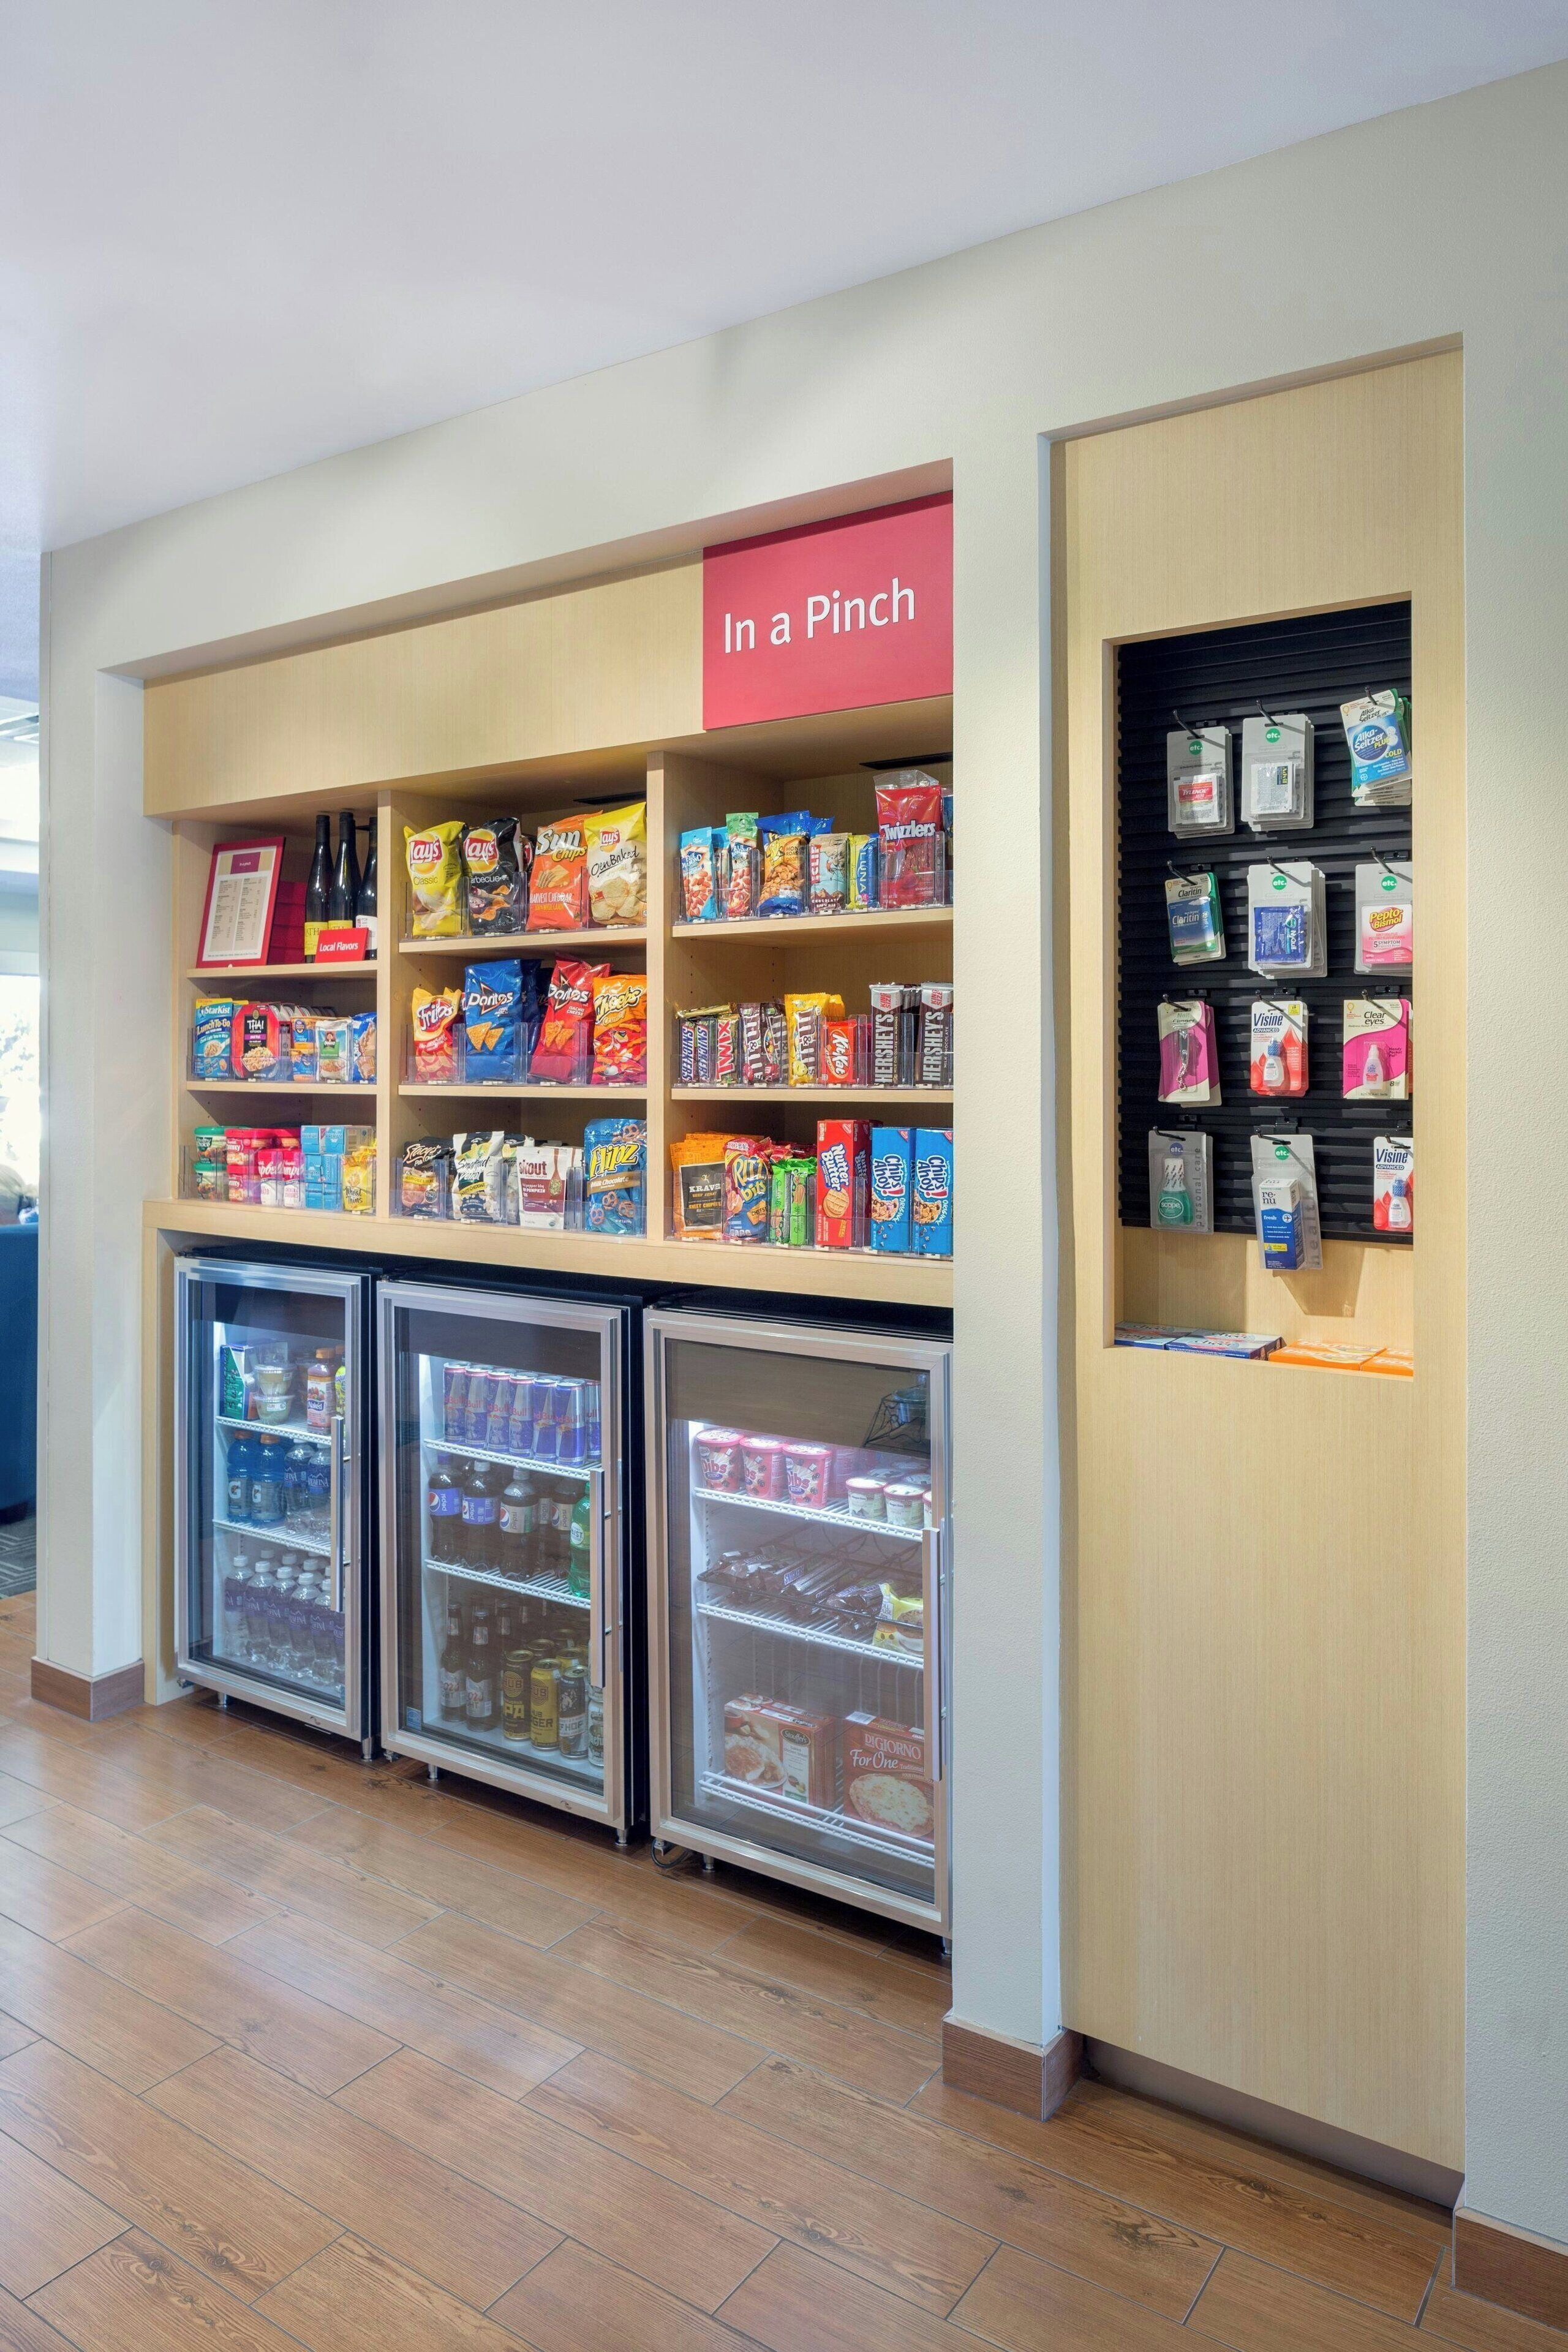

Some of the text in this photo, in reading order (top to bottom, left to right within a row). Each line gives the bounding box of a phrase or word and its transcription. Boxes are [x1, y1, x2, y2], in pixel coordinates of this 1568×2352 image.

[725, 576, 915, 654] In a Pinch
[1354, 732, 1384, 752] Seltzer
[1355, 729, 1378, 744] Alka-
[1374, 737, 1390, 749] PLUS
[1385, 748, 1402, 758] COLD
[600, 829, 620, 846] Lay's
[881, 820, 936, 841] Twizzlers
[466, 837, 495, 862] Lay's
[535, 829, 581, 855] Sun
[410, 839, 442, 864] Lay's
[552, 846, 587, 862] Chips
[610, 845, 639, 866] Baked
[413, 876, 438, 886] Classic
[470, 875, 500, 884] arbecue
[1178, 888, 1202, 898] Claritin
[1172, 914, 1199, 925] Claritin
[1369, 908, 1404, 923] Pepto-
[1374, 914, 1403, 930] Bismol
[319, 942, 336, 952] Local
[336, 941, 359, 951] Flavors
[468, 992, 513, 1006] Doritos
[548, 984, 589, 1002] Doritos
[205, 1005, 230, 1014] StarKist
[417, 1000, 454, 1031] Fritos
[197, 1020, 215, 1035] Lunch
[247, 1019, 264, 1030] THAI
[1254, 1012, 1283, 1027] Visine
[1365, 1018, 1384, 1027] eyes
[698, 1027, 709, 1080] SNICKERS
[716, 1020, 733, 1080] TWIX
[875, 1014, 894, 1084] HERSHEY'S
[923, 1011, 944, 1081] HERSHEY'S
[682, 1028, 694, 1082] SNICKERS
[404, 1144, 442, 1164] Stacy's
[590, 1144, 639, 1179] Flipz
[1376, 1148, 1408, 1164] Visine
[733, 1158, 767, 1187] RITZ
[821, 1150, 842, 1191] Butter
[831, 1144, 850, 1186] Nutter
[884, 1155, 902, 1189] Chips
[927, 1156, 946, 1190] Chips
[601, 1176, 629, 1186] Chocolate
[689, 1183, 722, 1193] KRAVE
[345, 1186, 361, 1197] Wheat
[741, 1179, 766, 1201] bits
[345, 1196, 363, 1205] Thins
[1193, 1177, 1205, 1227] personal
[892, 1198, 906, 1224] ORIGINAL
[936, 1199, 949, 1225] ORIGINAL
[308, 1401, 324, 1409] Naked
[228, 1481, 242, 1499] G
[252, 1485, 262, 1502] G
[785, 1730, 808, 1745] Stouffer's
[850, 1749, 899, 1769] For One
[899, 1763, 924, 1773] Traditional
